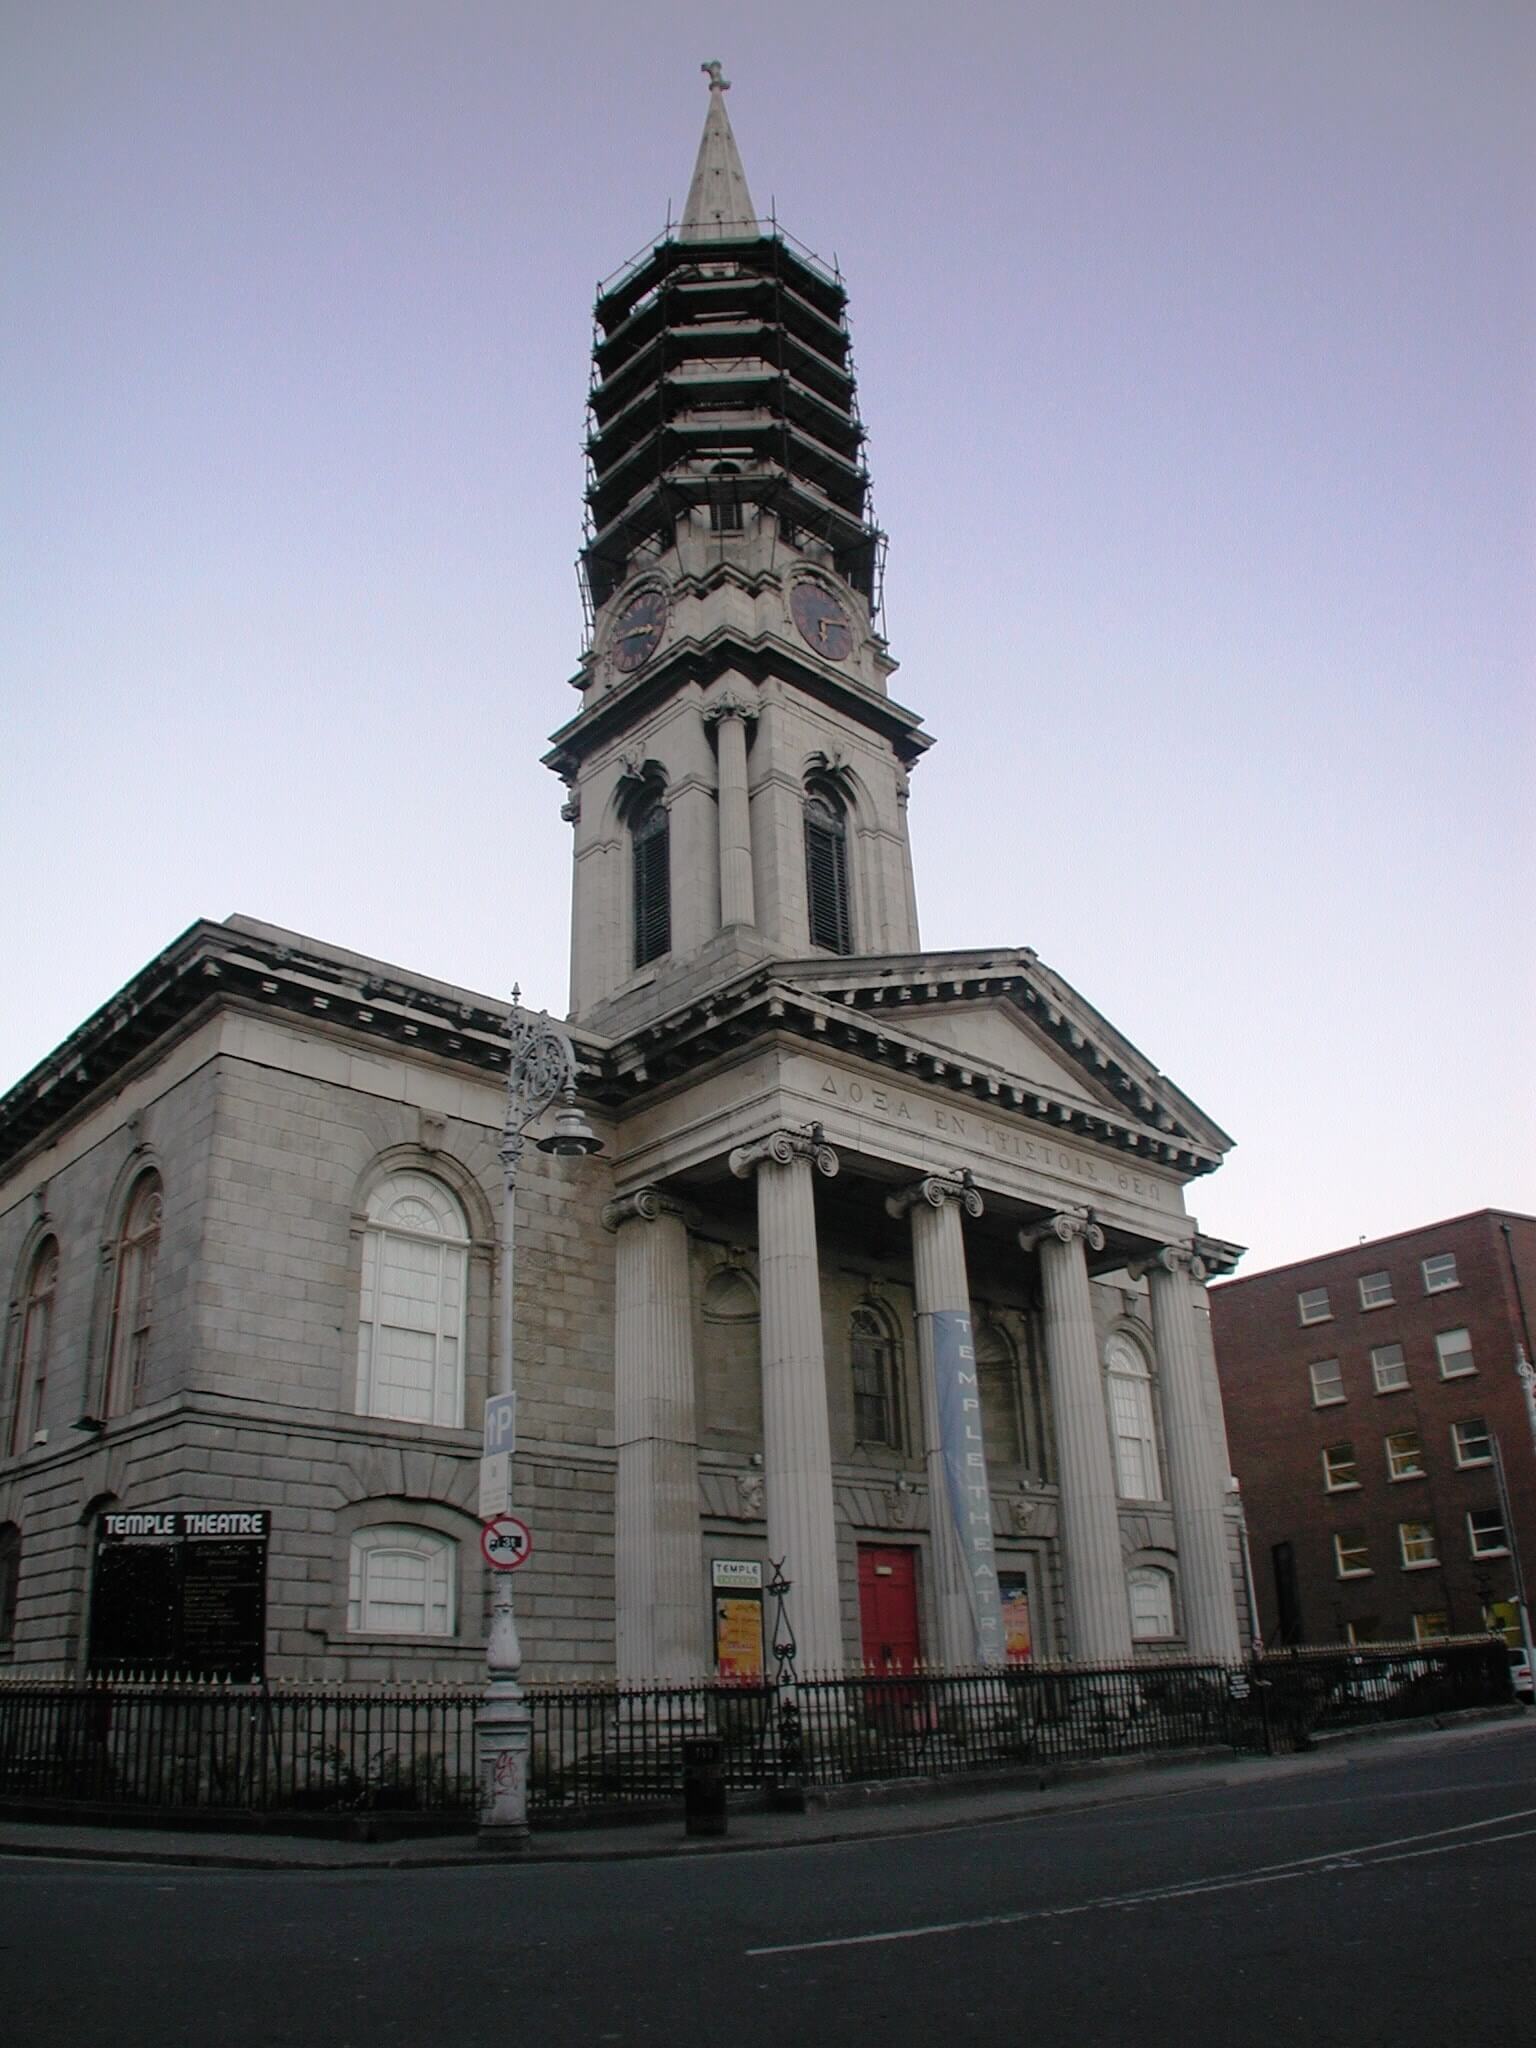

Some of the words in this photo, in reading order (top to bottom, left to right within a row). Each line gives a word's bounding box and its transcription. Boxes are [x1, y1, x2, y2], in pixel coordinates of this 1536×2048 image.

[954, 1318, 983, 1468] TEMPLE
[498, 1406, 512, 1444] P
[105, 1515, 175, 1534] TEMPLE
[184, 1514, 262, 1533] THEATRE
[716, 1564, 758, 1575] TEMPLE
